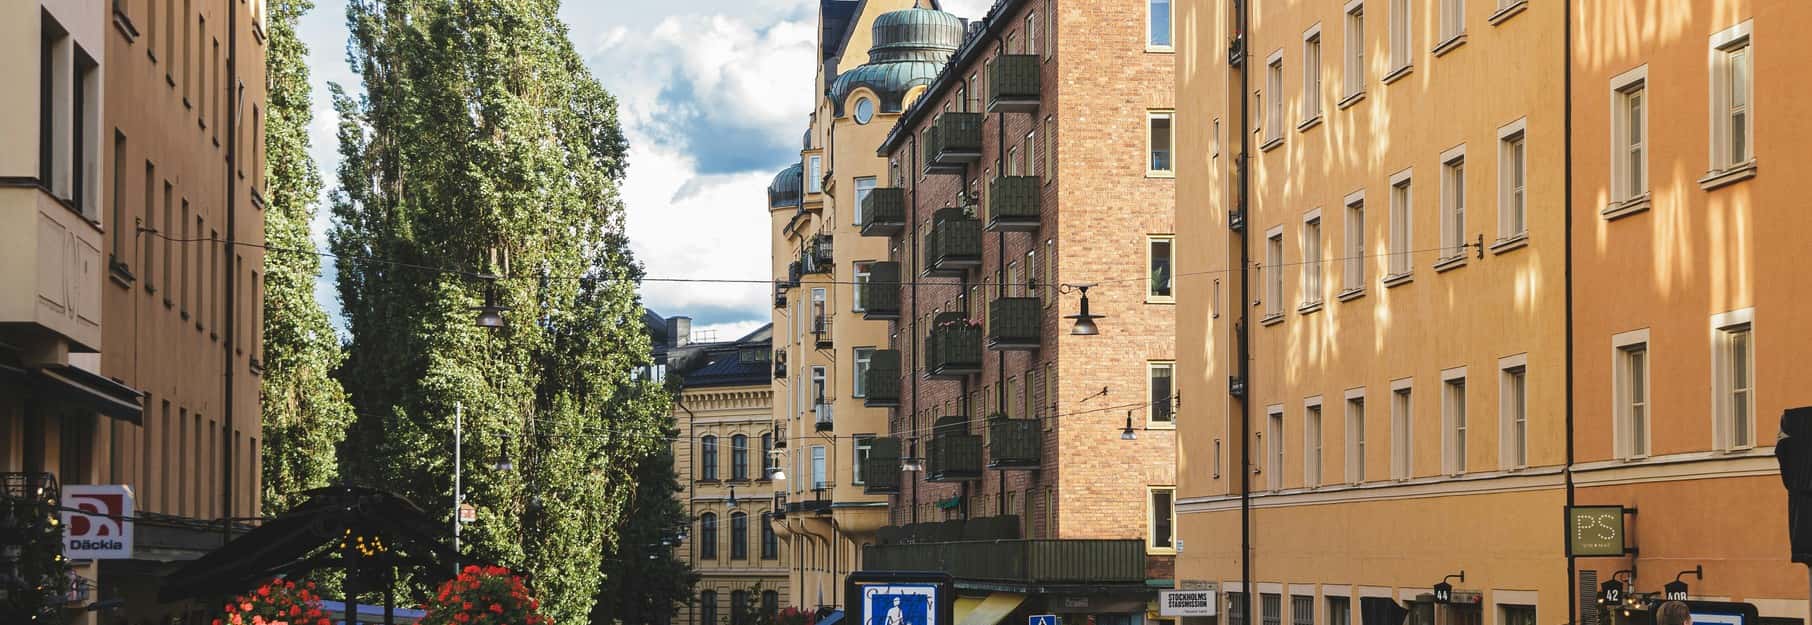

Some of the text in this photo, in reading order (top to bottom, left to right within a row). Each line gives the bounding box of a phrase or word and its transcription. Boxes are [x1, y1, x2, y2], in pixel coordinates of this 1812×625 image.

[1577, 514, 1615, 540] PS
[70, 539, 122, 550] Däckia
[1436, 590, 1448, 601] 44
[1606, 589, 1618, 601] 42
[1168, 600, 1207, 608] STADSMISSION
